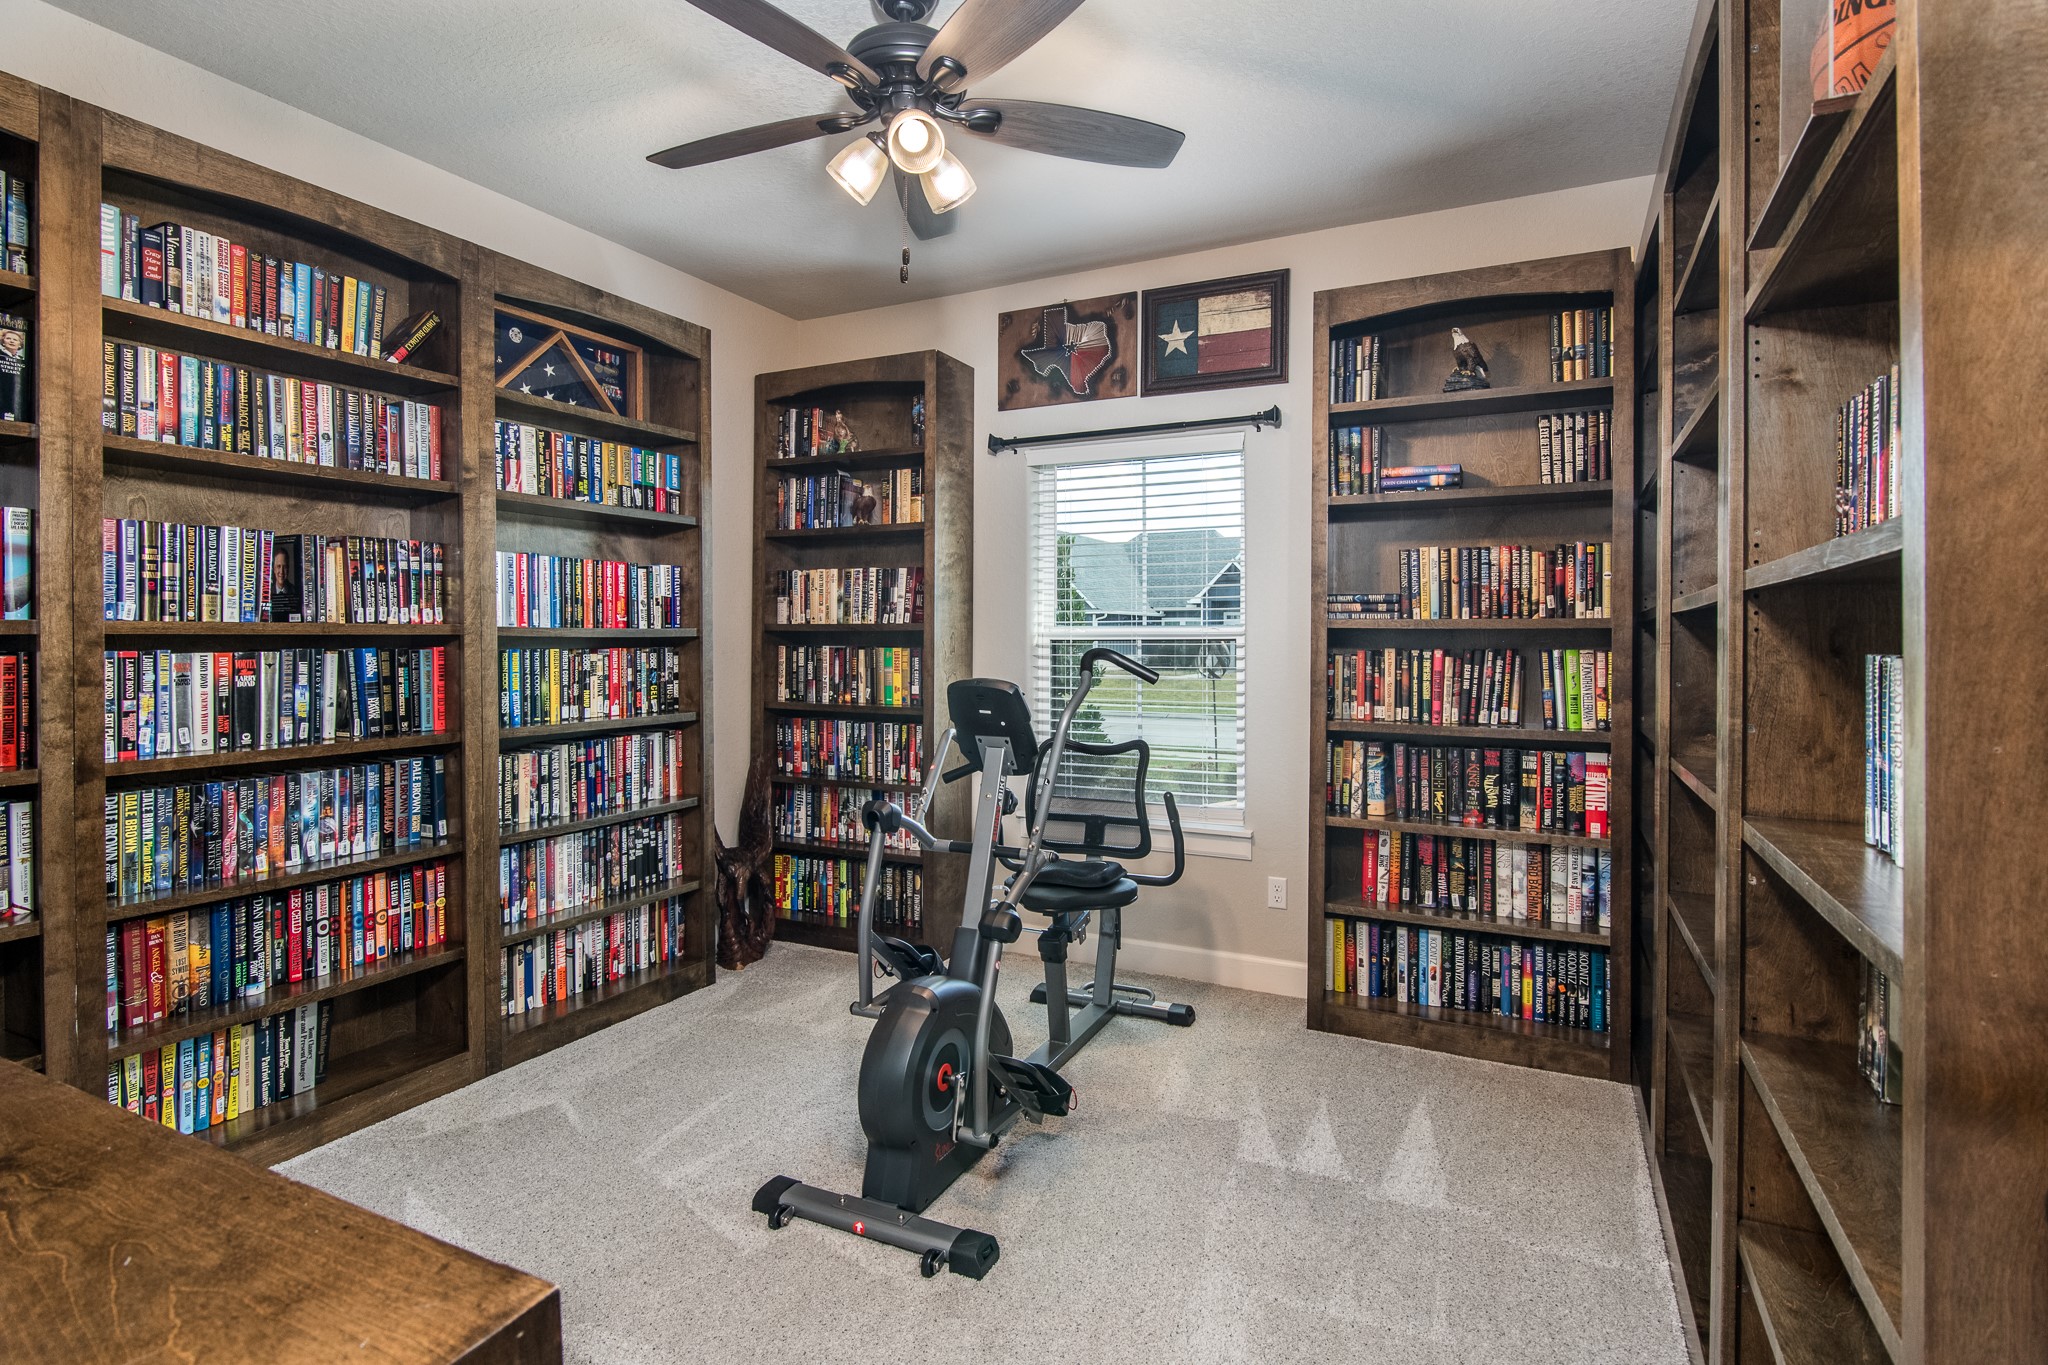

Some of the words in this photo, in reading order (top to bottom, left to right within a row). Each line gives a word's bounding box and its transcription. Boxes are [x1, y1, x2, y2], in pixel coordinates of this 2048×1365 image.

[144, 250, 161, 259] Crazy
[167, 237, 179, 266] Victors
[105, 342, 114, 363] DAVID
[124, 348, 134, 369] DAVID
[105, 364, 115, 396] BALDACCI
[124, 370, 134, 403] BALDACCI
[304, 384, 315, 410] DAVID
[348, 393, 358, 412] DAVID
[305, 410, 317, 450] BALDACCI
[209, 529, 217, 548] DAVID
[227, 528, 236, 550] DAVID
[208, 549, 217, 580] BALDACCI
[1400, 568, 1408, 588] HIGGINS
[3, 663, 15, 677] THE
[106, 659, 114, 680] LARRY
[125, 659, 134, 679] LARRY
[199, 655, 208, 674] LARRY
[235, 659, 256, 669] VORTEX
[106, 680, 114, 699] BOND
[125, 679, 134, 698] BOND
[199, 674, 208, 688] BOND
[3, 678, 15, 708] TERROR
[2, 708, 15, 745] NETWORK
[400, 763, 408, 780] DALE
[413, 761, 421, 779] DALE
[1467, 764, 1477, 787] KING
[125, 794, 137, 818] DALE
[142, 793, 153, 813] DALE
[399, 780, 408, 814] BROWN
[412, 780, 421, 815] BROWN
[1585, 779, 1608, 812] KING
[22, 812, 30, 820] NO
[106, 796, 118, 822] DALE
[22, 822, 32, 840] EASY
[125, 818, 138, 854] BROWN
[142, 813, 154, 841] BROWN
[179, 815, 189, 843] SHADOW
[22, 841, 32, 855] DAY
[106, 822, 118, 862] BROWN
[1552, 847, 1560, 872] KING
[1438, 873, 1448, 898] REVIVAL
[253, 899, 263, 918] DAN
[292, 894, 301, 908] LEE
[292, 910, 301, 933] CHILD
[253, 919, 264, 952] BROWN
[1568, 950, 1577, 985] KOONTZ
[1579, 951, 1589, 986] KOONTZ
[261, 1056, 271, 1081] Patriot
[184, 1092, 192, 1105] BLUE
[184, 1105, 192, 1117] MOON
